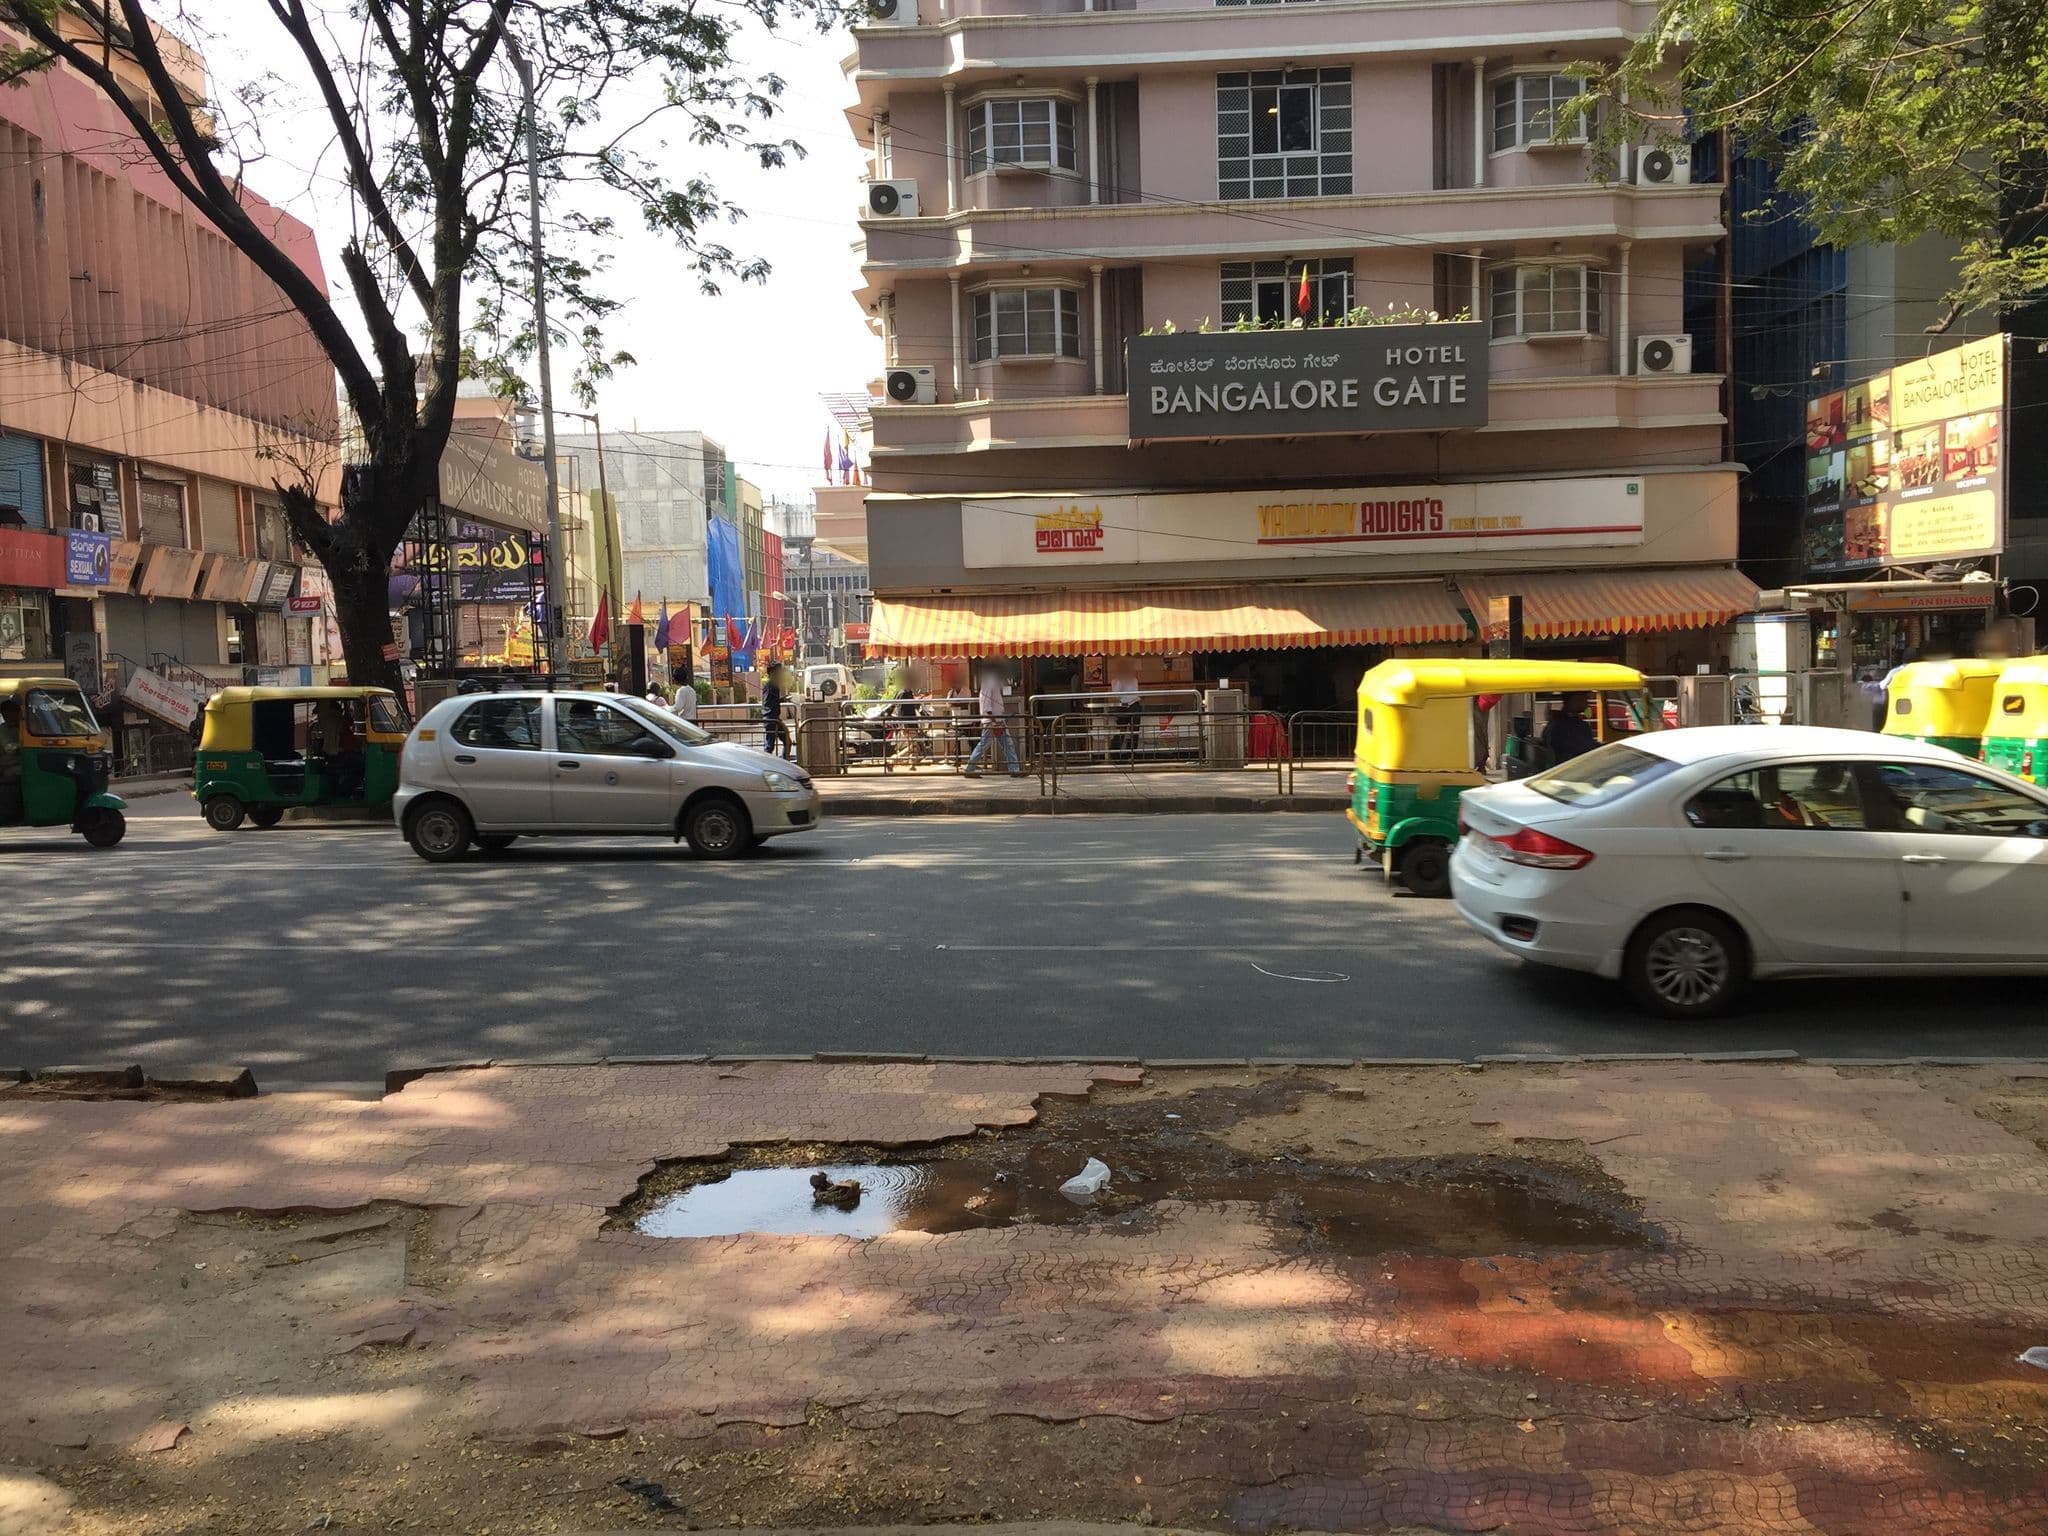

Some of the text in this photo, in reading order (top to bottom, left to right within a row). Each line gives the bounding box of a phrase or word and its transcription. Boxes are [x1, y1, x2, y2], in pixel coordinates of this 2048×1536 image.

[1149, 352, 1341, 374] ಹೋಟೆಲ್ ಬೆಂಗಳೂರು ಗೇಟ್
[1386, 345, 1466, 366] HOTEL
[1961, 350, 1998, 370] HOTEL
[1151, 374, 1467, 416] BANGALORE GATE
[1903, 376, 1966, 409] BANGALORE
[1968, 367, 1998, 391] GATE
[518, 465, 541, 489] HOTEL
[446, 462, 543, 524] BANGALORE GATE
[1361, 497, 1443, 533] ADIGA'S
[70, 560, 94, 575] SEXUAL
[1910, 594, 1994, 606] PAN BHANDAR
